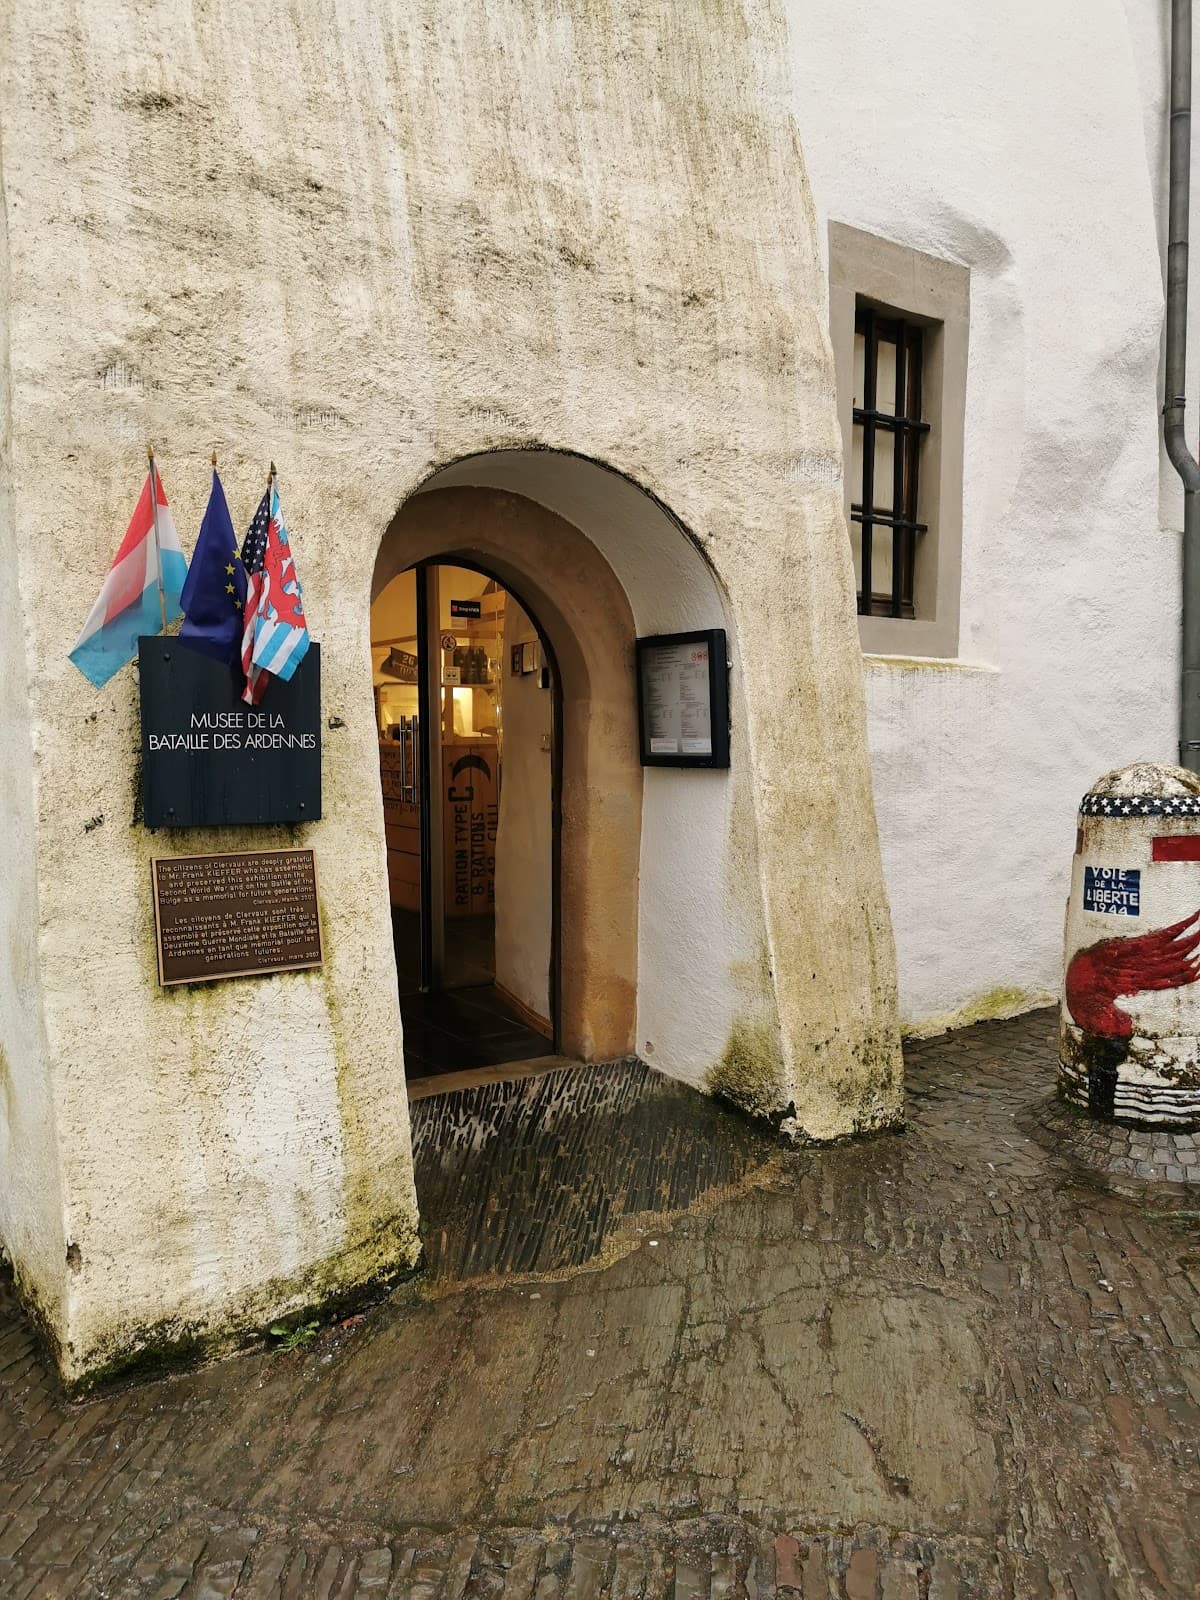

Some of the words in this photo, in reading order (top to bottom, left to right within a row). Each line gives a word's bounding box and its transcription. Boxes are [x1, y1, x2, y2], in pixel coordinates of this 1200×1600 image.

[190, 713, 244, 728] MUSEE
[248, 713, 265, 728] DE
[269, 714, 285, 728] LA
[149, 735, 209, 750] BATAILLE
[214, 734, 241, 749] DES
[244, 734, 316, 749] ARDENNES
[448, 787, 473, 802] C
[455, 805, 467, 845] TYPE
[471, 812, 485, 877] RATIONS
[173, 863, 203, 872] citizens
[214, 860, 245, 869] Clervaux
[262, 858, 283, 867] deeply
[286, 856, 312, 865] grateful
[182, 871, 204, 879] Frank
[207, 869, 241, 877] KIEFFER
[275, 864, 313, 872] assembled
[187, 878, 226, 888] preserved
[246, 874, 282, 882] exhibition
[455, 850, 468, 905] RATION
[1092, 868, 1127, 880] VOIE
[160, 889, 187, 897] Second
[160, 897, 181, 907] Bulge
[202, 892, 236, 902] memorial
[1087, 889, 1139, 907] LIBERTE
[174, 916, 188, 925] Les
[191, 913, 221, 924] citoyens
[236, 909, 268, 919] Clervaux
[272, 907, 287, 915] sont
[1093, 903, 1128, 915] 1944
[162, 921, 220, 934] reconnaissants
[241, 917, 261, 926] Frank
[264, 914, 296, 924] KIEFFER
[163, 932, 199, 942] assemblé
[210, 928, 241, 939] préservé
[244, 926, 260, 934] cette
[263, 922, 297, 933] exposition
[163, 940, 200, 950] Deuxième
[201, 937, 227, 946] Guerre
[229, 933, 259, 943] Mondiale
[278, 929, 304, 938] Bataille
[306, 927, 318, 935] des
[168, 947, 205, 958] Ardennes
[219, 944, 233, 952] tant
[251, 939, 283, 948] mémorial
[286, 938, 302, 946] pour
[205, 950, 250, 963] générations
